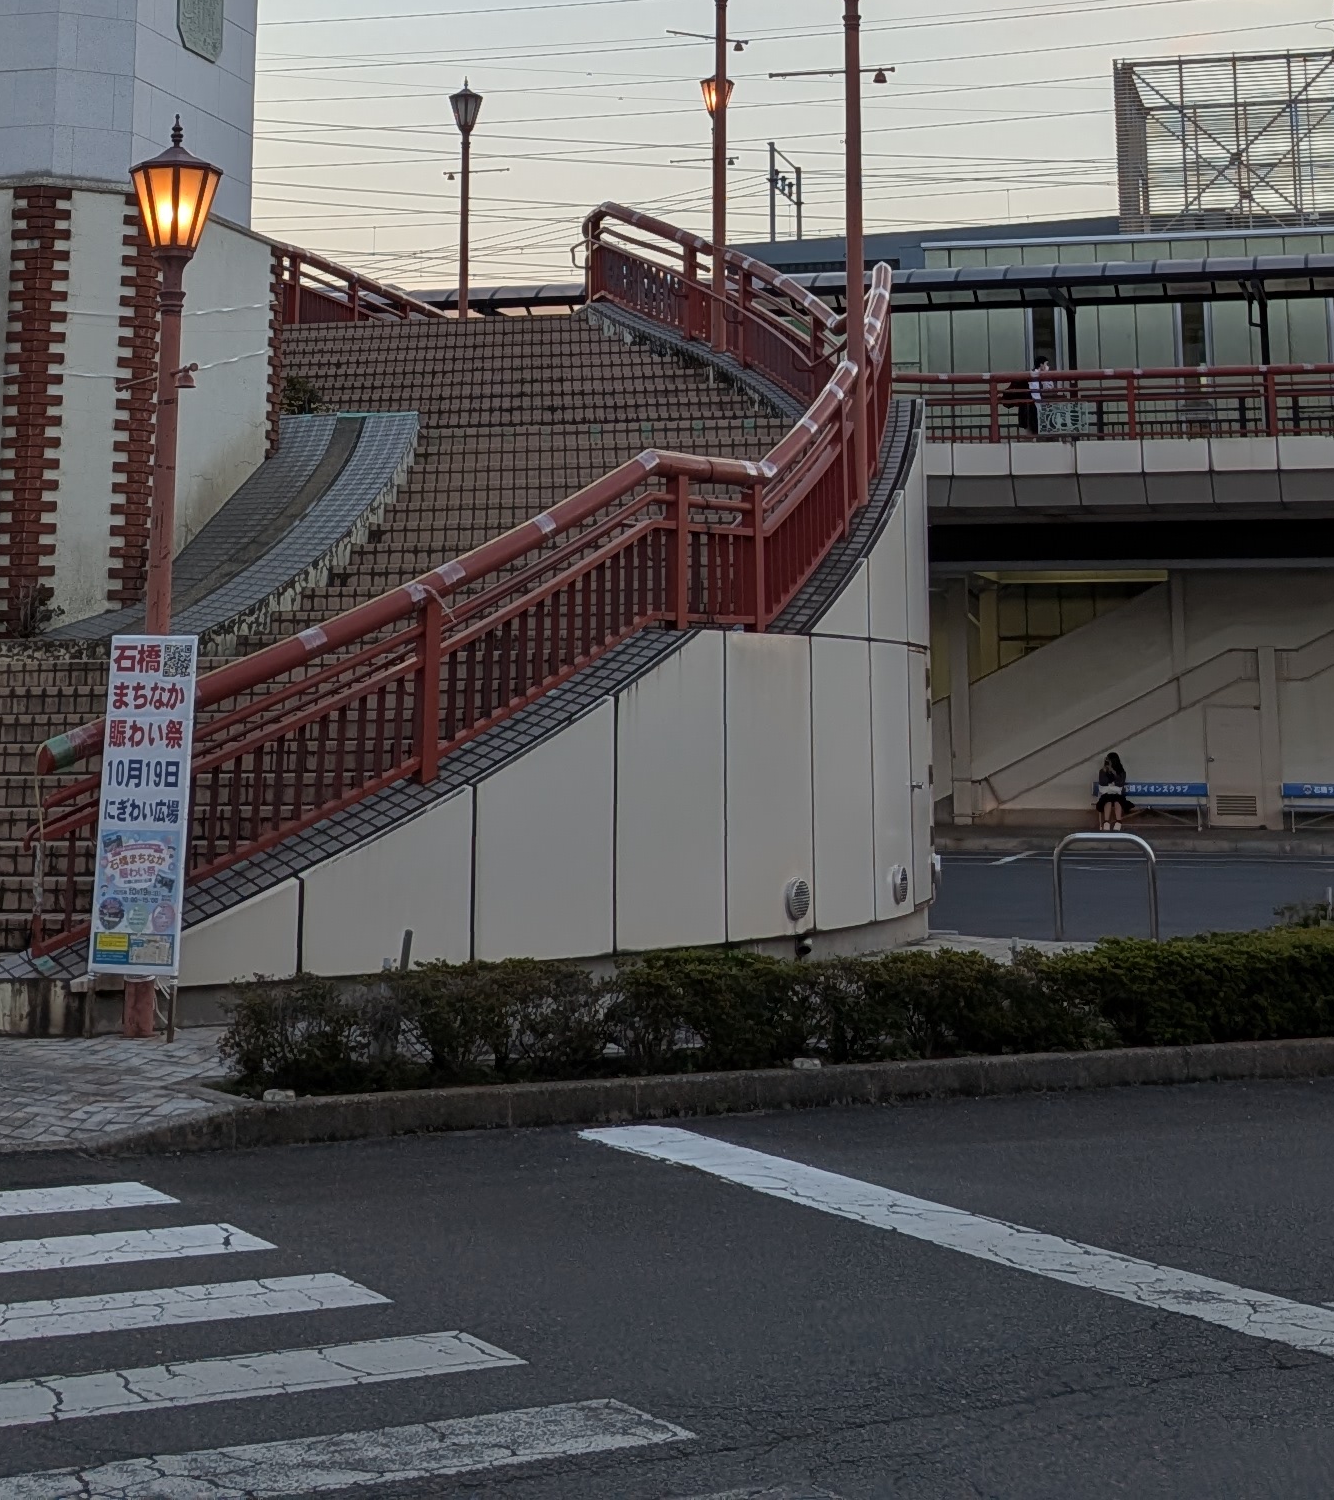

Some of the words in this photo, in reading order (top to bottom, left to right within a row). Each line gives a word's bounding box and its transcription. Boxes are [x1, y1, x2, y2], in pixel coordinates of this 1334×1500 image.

[113, 643, 162, 674] 石橋
[112, 682, 185, 711] まちなか
[108, 719, 184, 749] 賑わい祭
[106, 759, 180, 789] 10月19日
[103, 798, 180, 824] にぎわい広場
